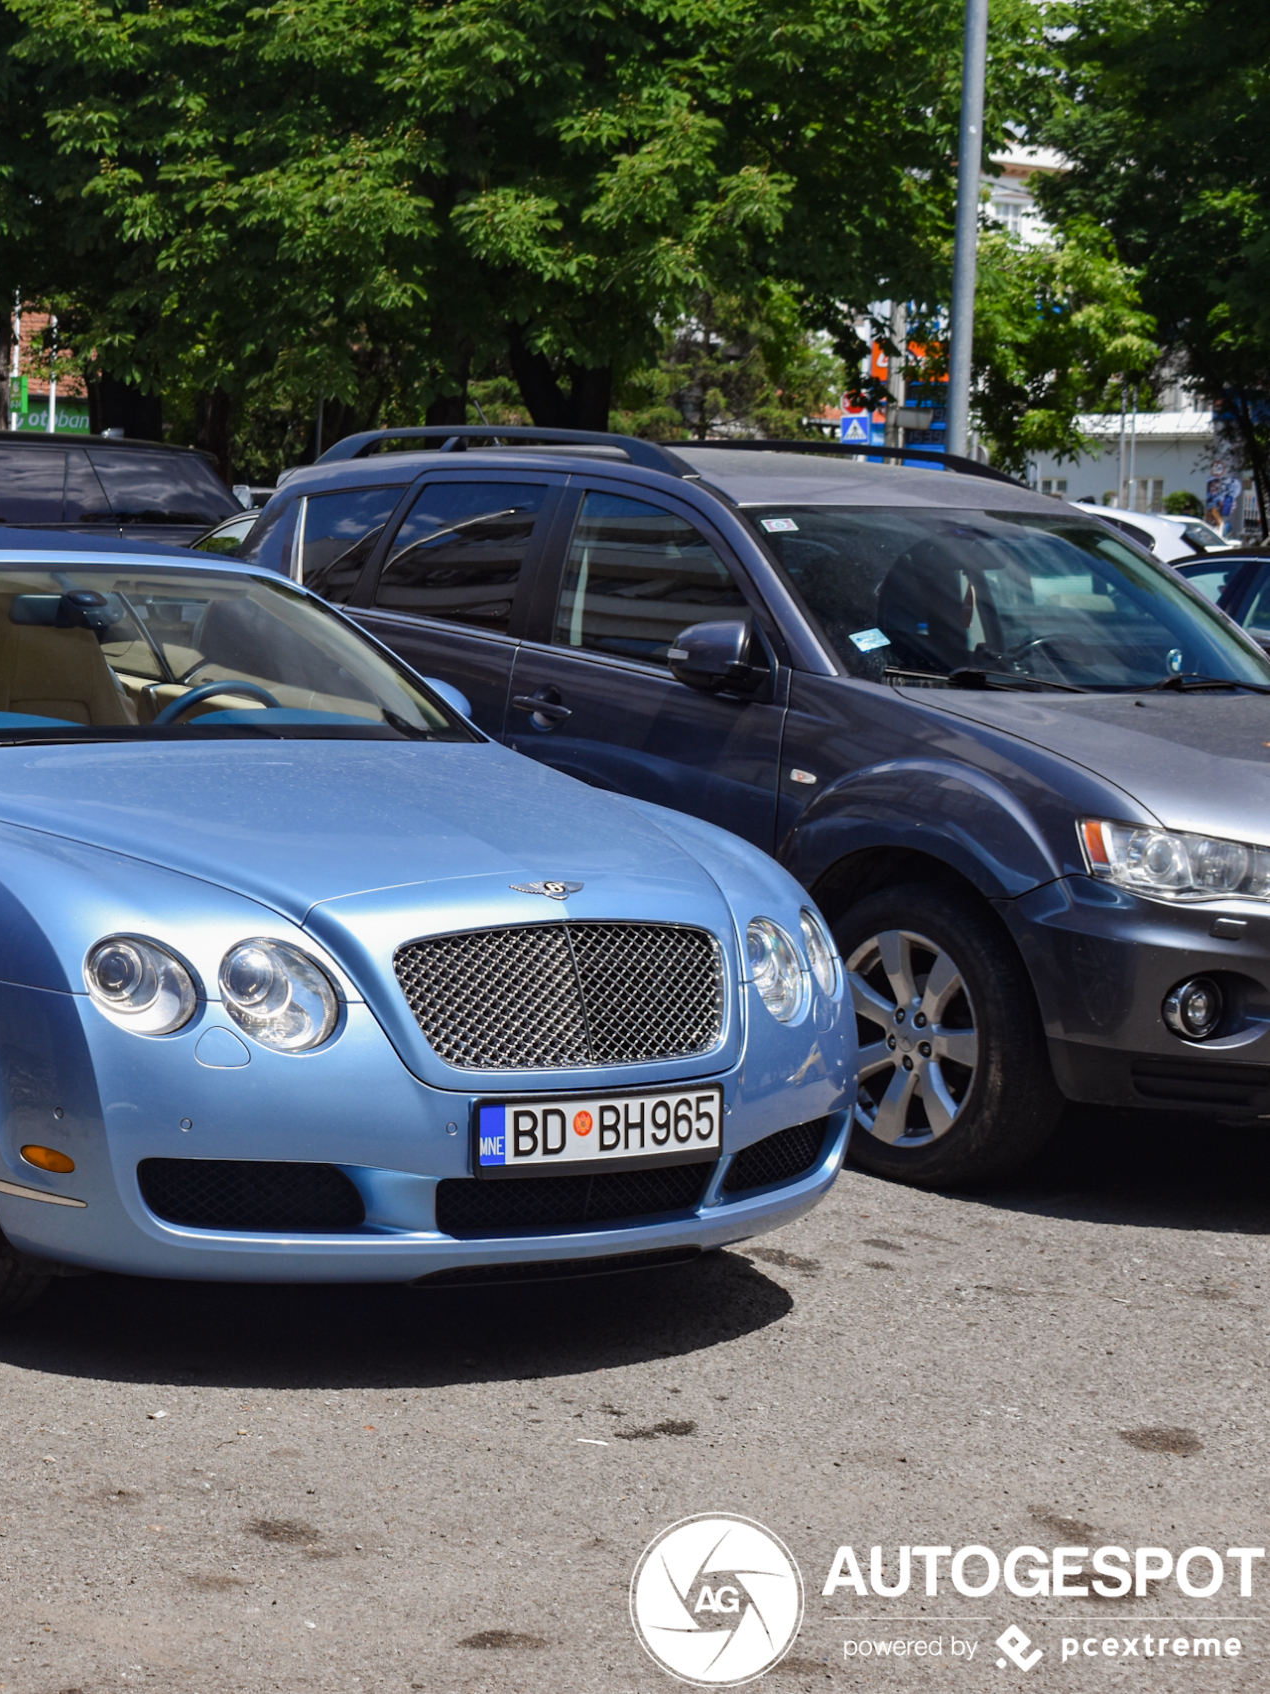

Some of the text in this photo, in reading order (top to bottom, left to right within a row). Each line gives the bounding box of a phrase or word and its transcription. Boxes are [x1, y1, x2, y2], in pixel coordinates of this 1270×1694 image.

[480, 1096, 714, 1157] MNE BD BH965
